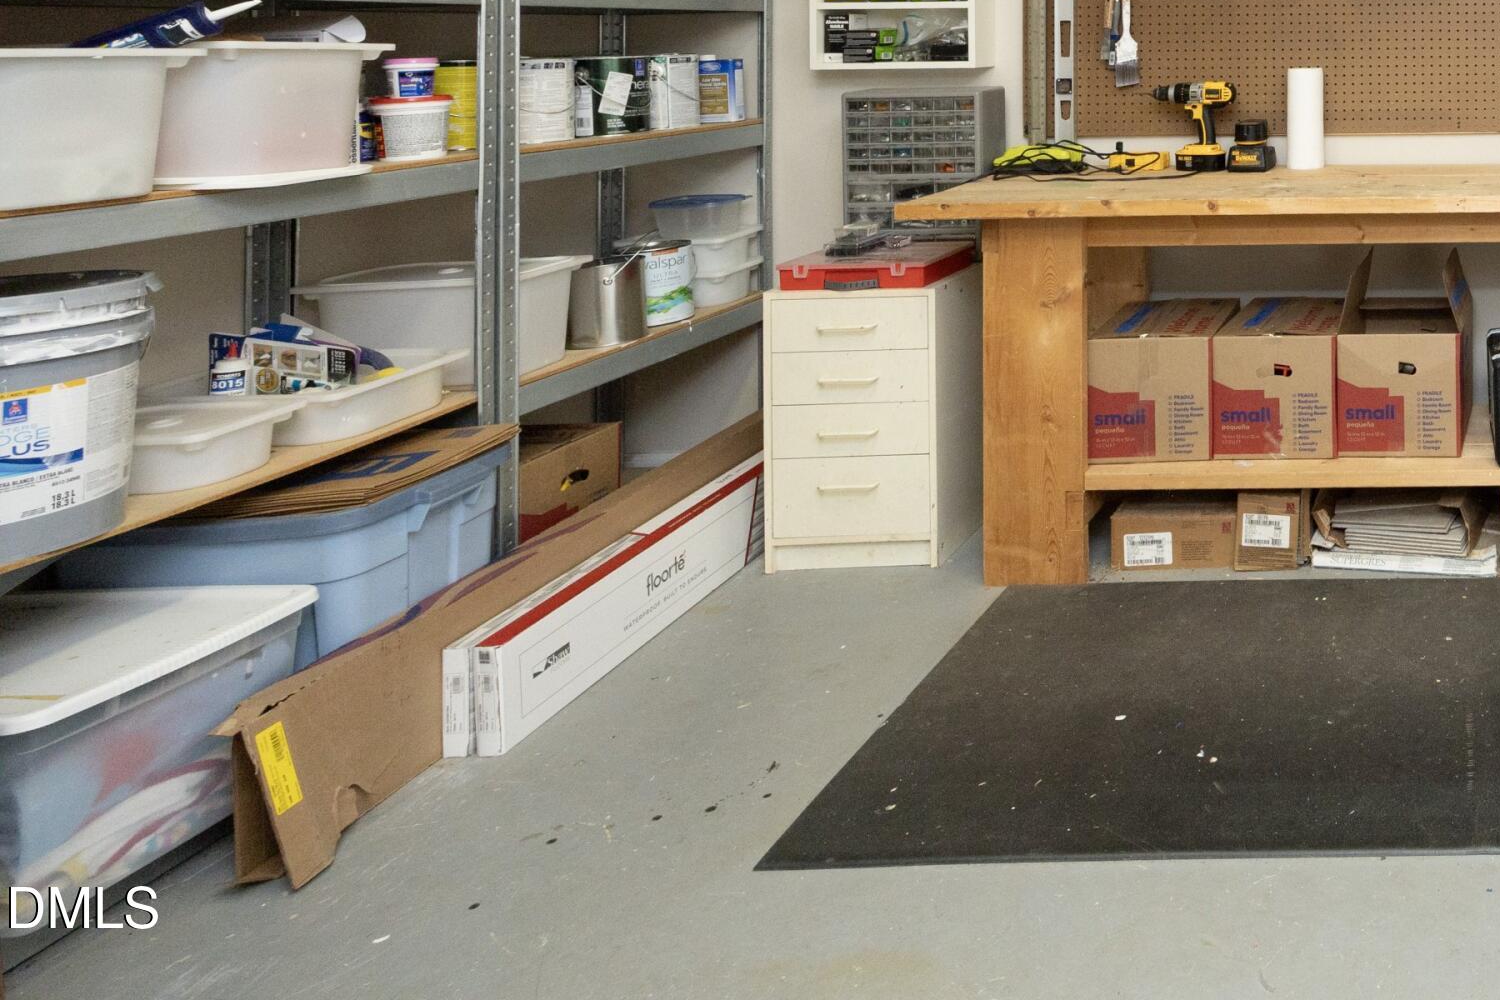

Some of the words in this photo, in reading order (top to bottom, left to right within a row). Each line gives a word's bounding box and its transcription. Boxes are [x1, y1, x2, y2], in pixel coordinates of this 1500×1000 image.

[212, 379, 243, 390] 8015
[1095, 408, 1146, 425] small
[1221, 407, 1271, 422] small
[1345, 404, 1395, 420] small
[647, 552, 686, 596] floorté
